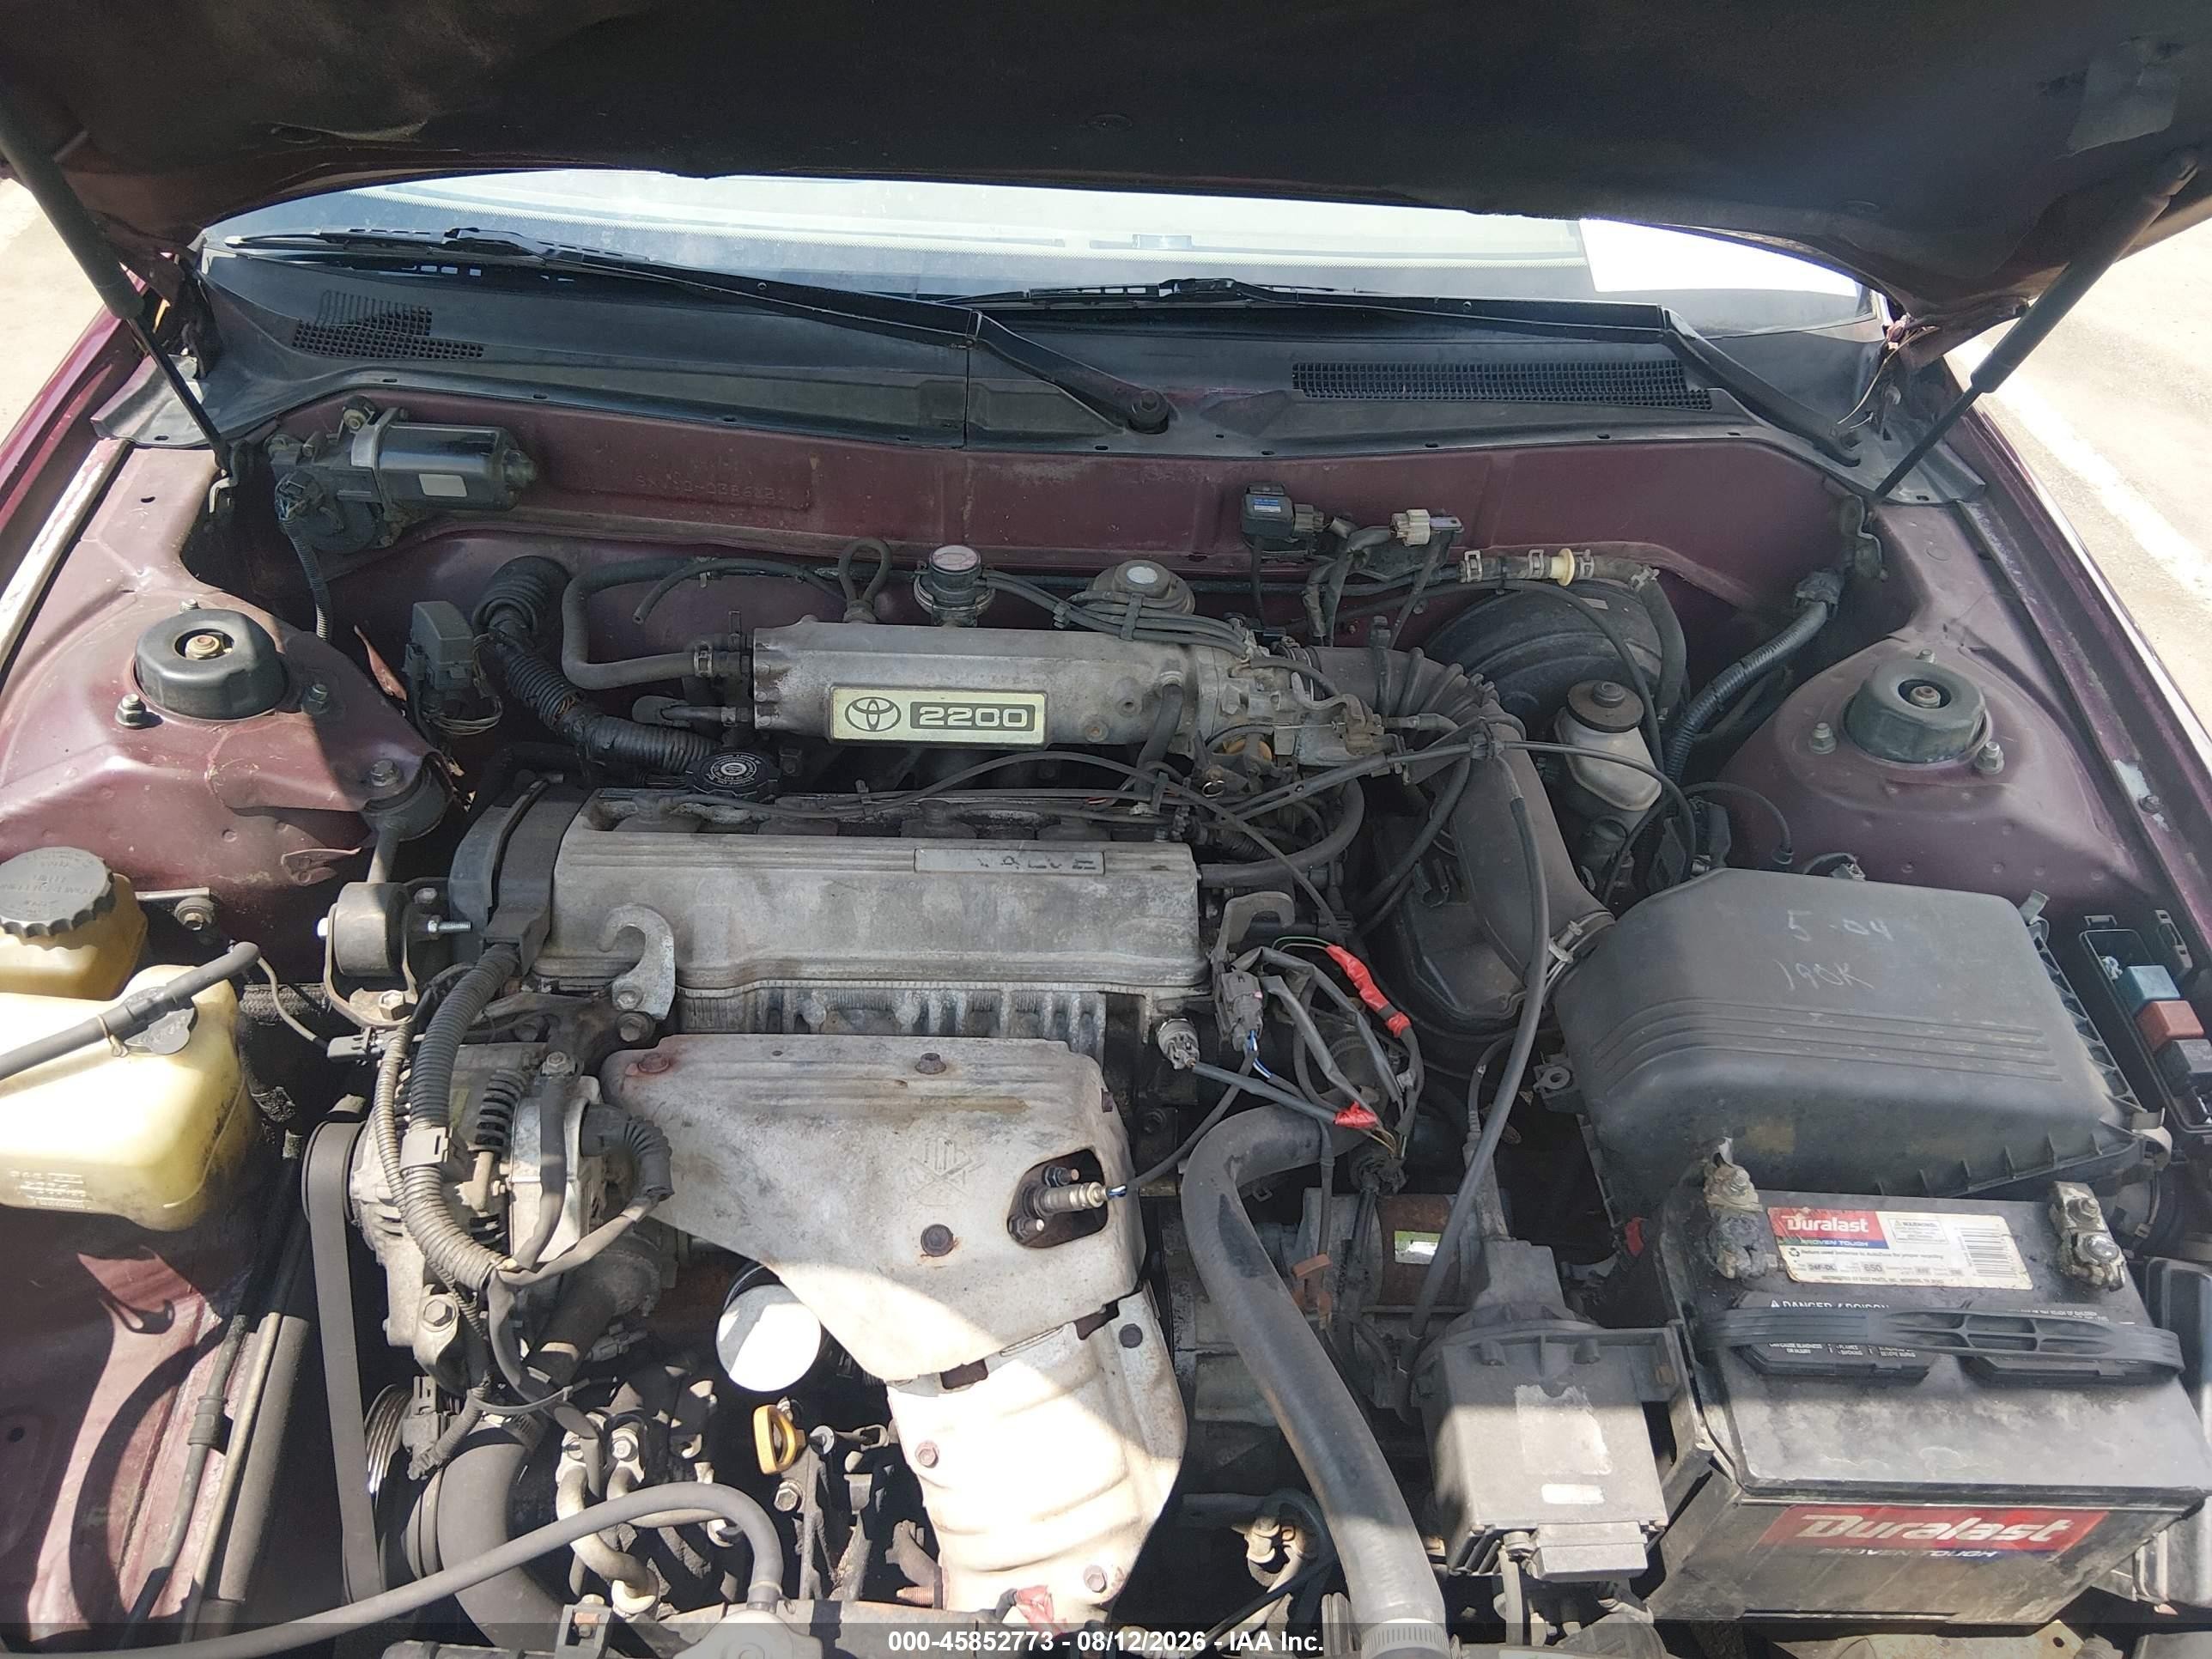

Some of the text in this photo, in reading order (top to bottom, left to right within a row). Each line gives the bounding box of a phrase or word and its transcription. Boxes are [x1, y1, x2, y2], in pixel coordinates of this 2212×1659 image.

[919, 705, 1028, 728] 2200
[1781, 1212, 1869, 1233] Duralast
[1795, 1514, 2075, 1542] Duralast
